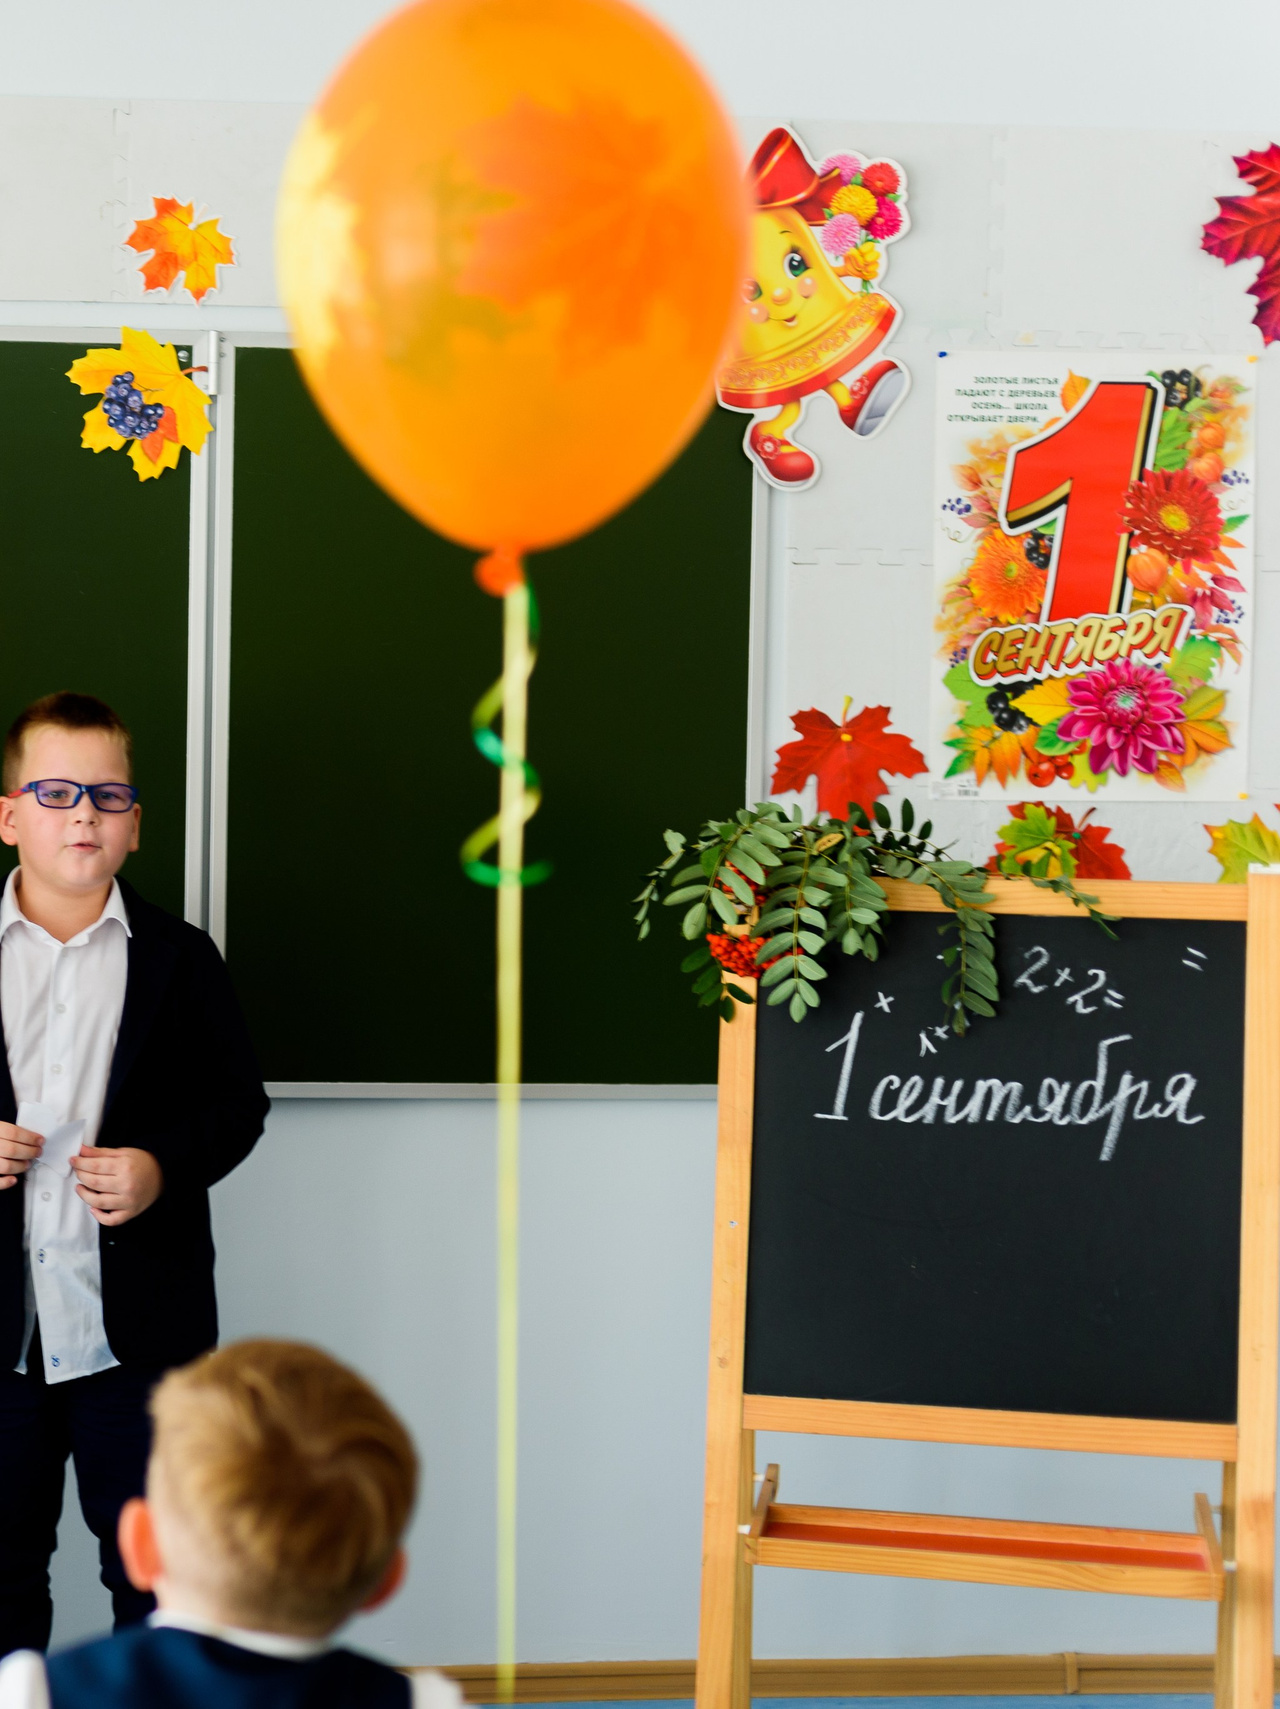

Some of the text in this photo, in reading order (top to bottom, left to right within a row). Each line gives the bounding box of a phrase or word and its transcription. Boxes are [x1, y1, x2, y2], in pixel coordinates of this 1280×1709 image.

[973, 376, 1059, 386] ЗОЛОТЫЕ ЛИСТЬЯ
[954, 388, 996, 397] ПАДАЮТ
[998, 389, 1006, 397] С
[1014, 402, 1048, 411] ШКОЛА
[946, 414, 1003, 423] ОТКРЫВАЕТ
[1004, 380, 1160, 622] 1
[972, 606, 1188, 682] СЕНТЯБРЯ
[814, 1010, 1206, 1162] 1 сентября
